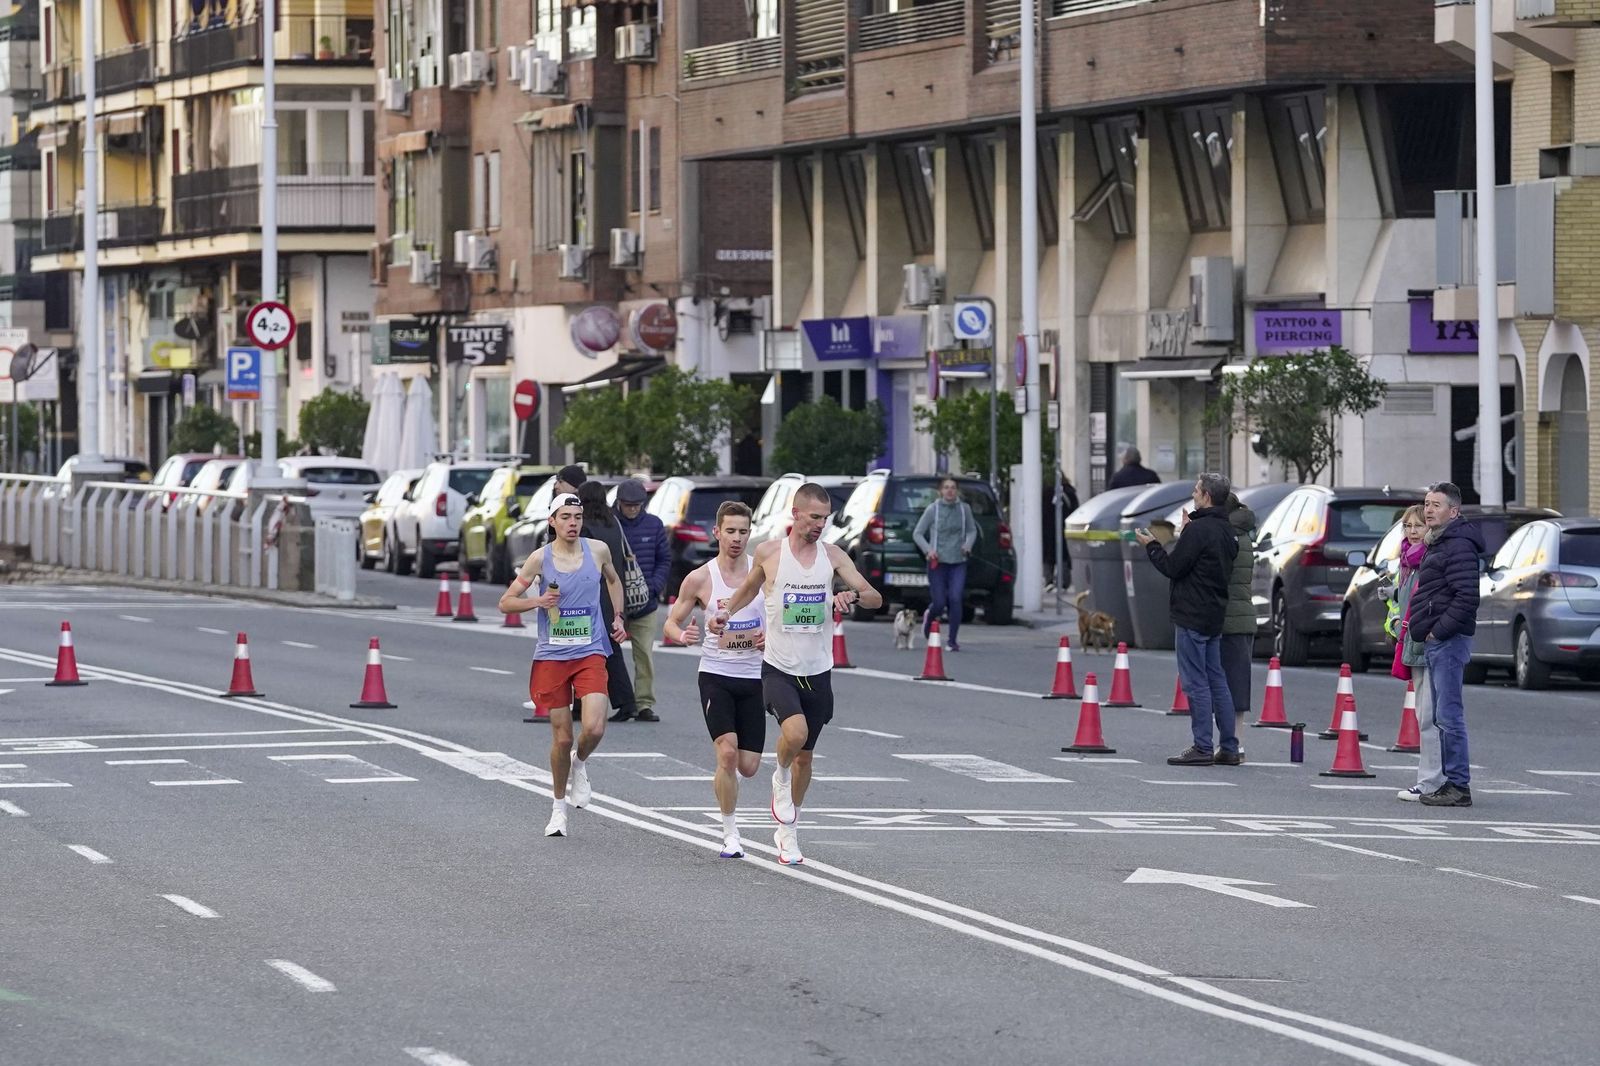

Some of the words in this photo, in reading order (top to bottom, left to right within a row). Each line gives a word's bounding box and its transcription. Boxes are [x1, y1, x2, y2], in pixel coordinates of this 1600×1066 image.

[1265, 317, 1317, 328] TATTOO
[1322, 318, 1331, 327] &
[448, 328, 503, 342] TINTE
[1265, 331, 1332, 341] PIERCING
[463, 341, 497, 366] 5€
[231, 352, 252, 381] P
[795, 615, 816, 624] VOET
[732, 622, 757, 630] ZURICH
[552, 627, 589, 636] MANUELE
[726, 640, 753, 649] JAKOB
